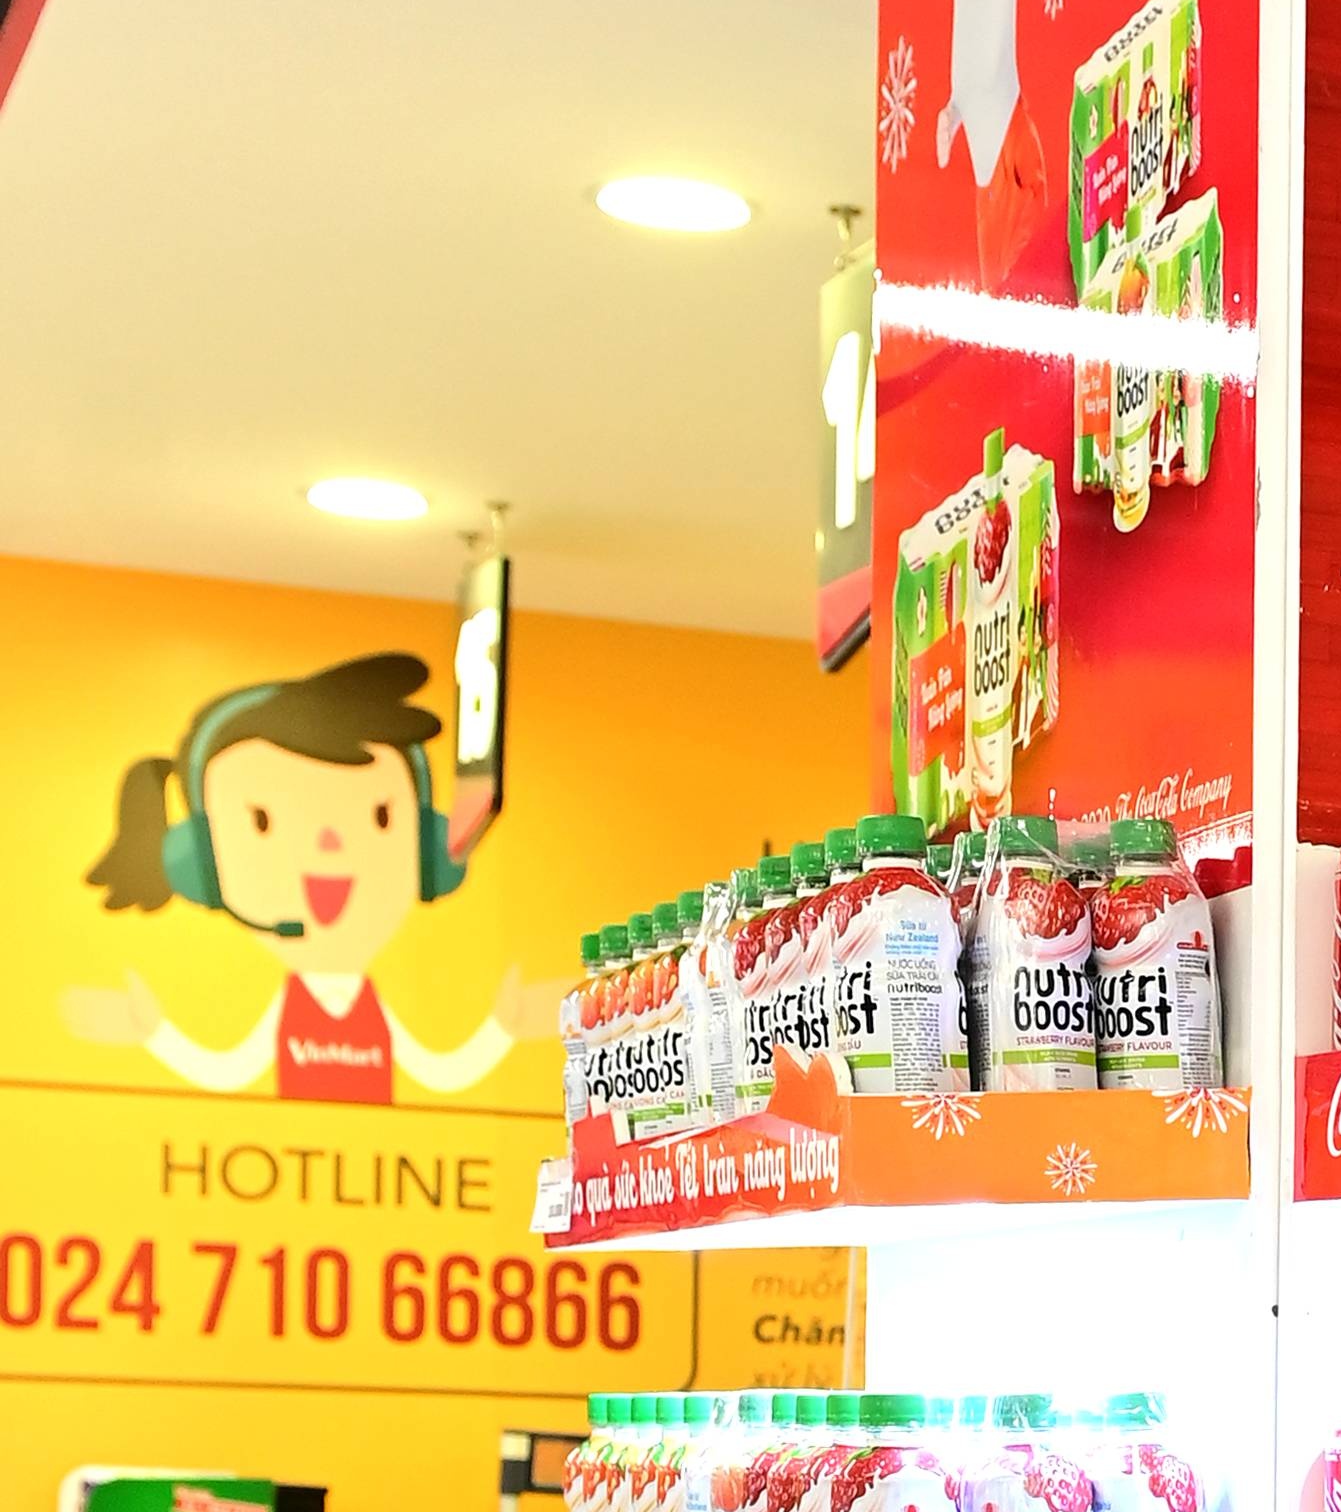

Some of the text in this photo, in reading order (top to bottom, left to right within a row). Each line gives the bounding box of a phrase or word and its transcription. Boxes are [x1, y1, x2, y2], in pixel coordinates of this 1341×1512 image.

[974, 602, 1011, 663] nutri
[974, 646, 1011, 697] boost
[159, 1140, 498, 1213] HOTLINE
[586, 1162, 612, 1227] quà
[614, 1159, 638, 1210] sức
[676, 1140, 699, 1200] Tết
[703, 1142, 739, 1197] tràn
[744, 1140, 786, 1201] năng
[789, 1128, 840, 1199] lượng
[0, 1232, 645, 1353] 024 710 66866
